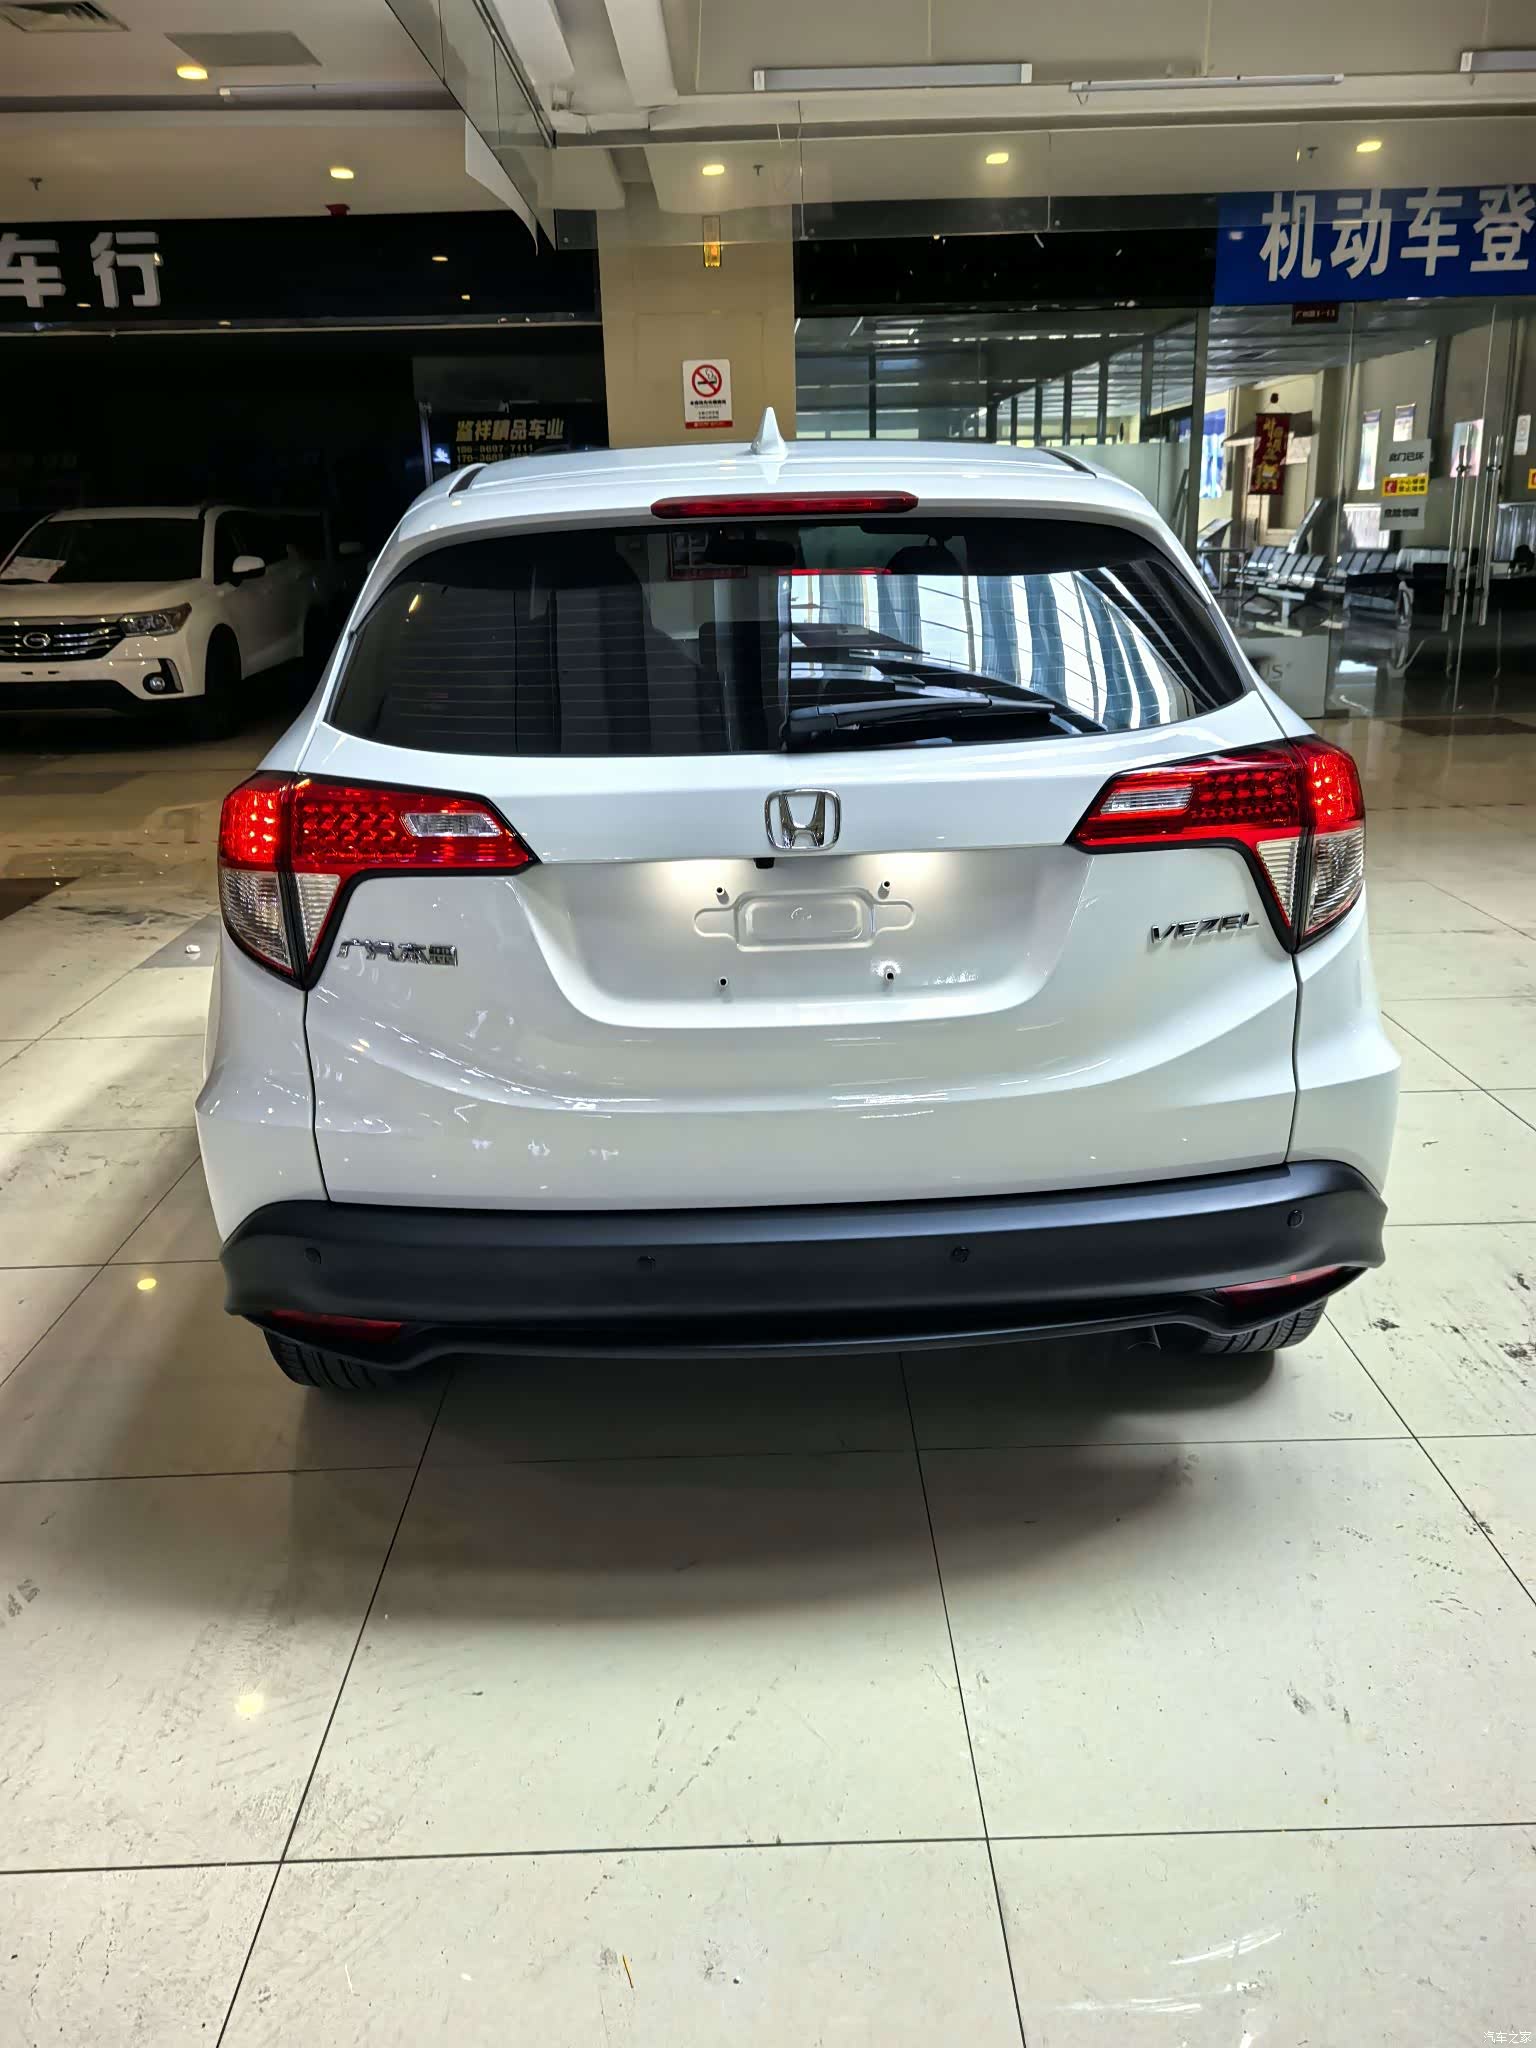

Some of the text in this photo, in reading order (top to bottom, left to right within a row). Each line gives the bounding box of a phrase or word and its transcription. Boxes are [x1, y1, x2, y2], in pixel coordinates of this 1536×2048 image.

[0, 231, 163, 308] 车行
[1259, 185, 1536, 282] 机动车登
[1149, 912, 1260, 944] VEZEL
